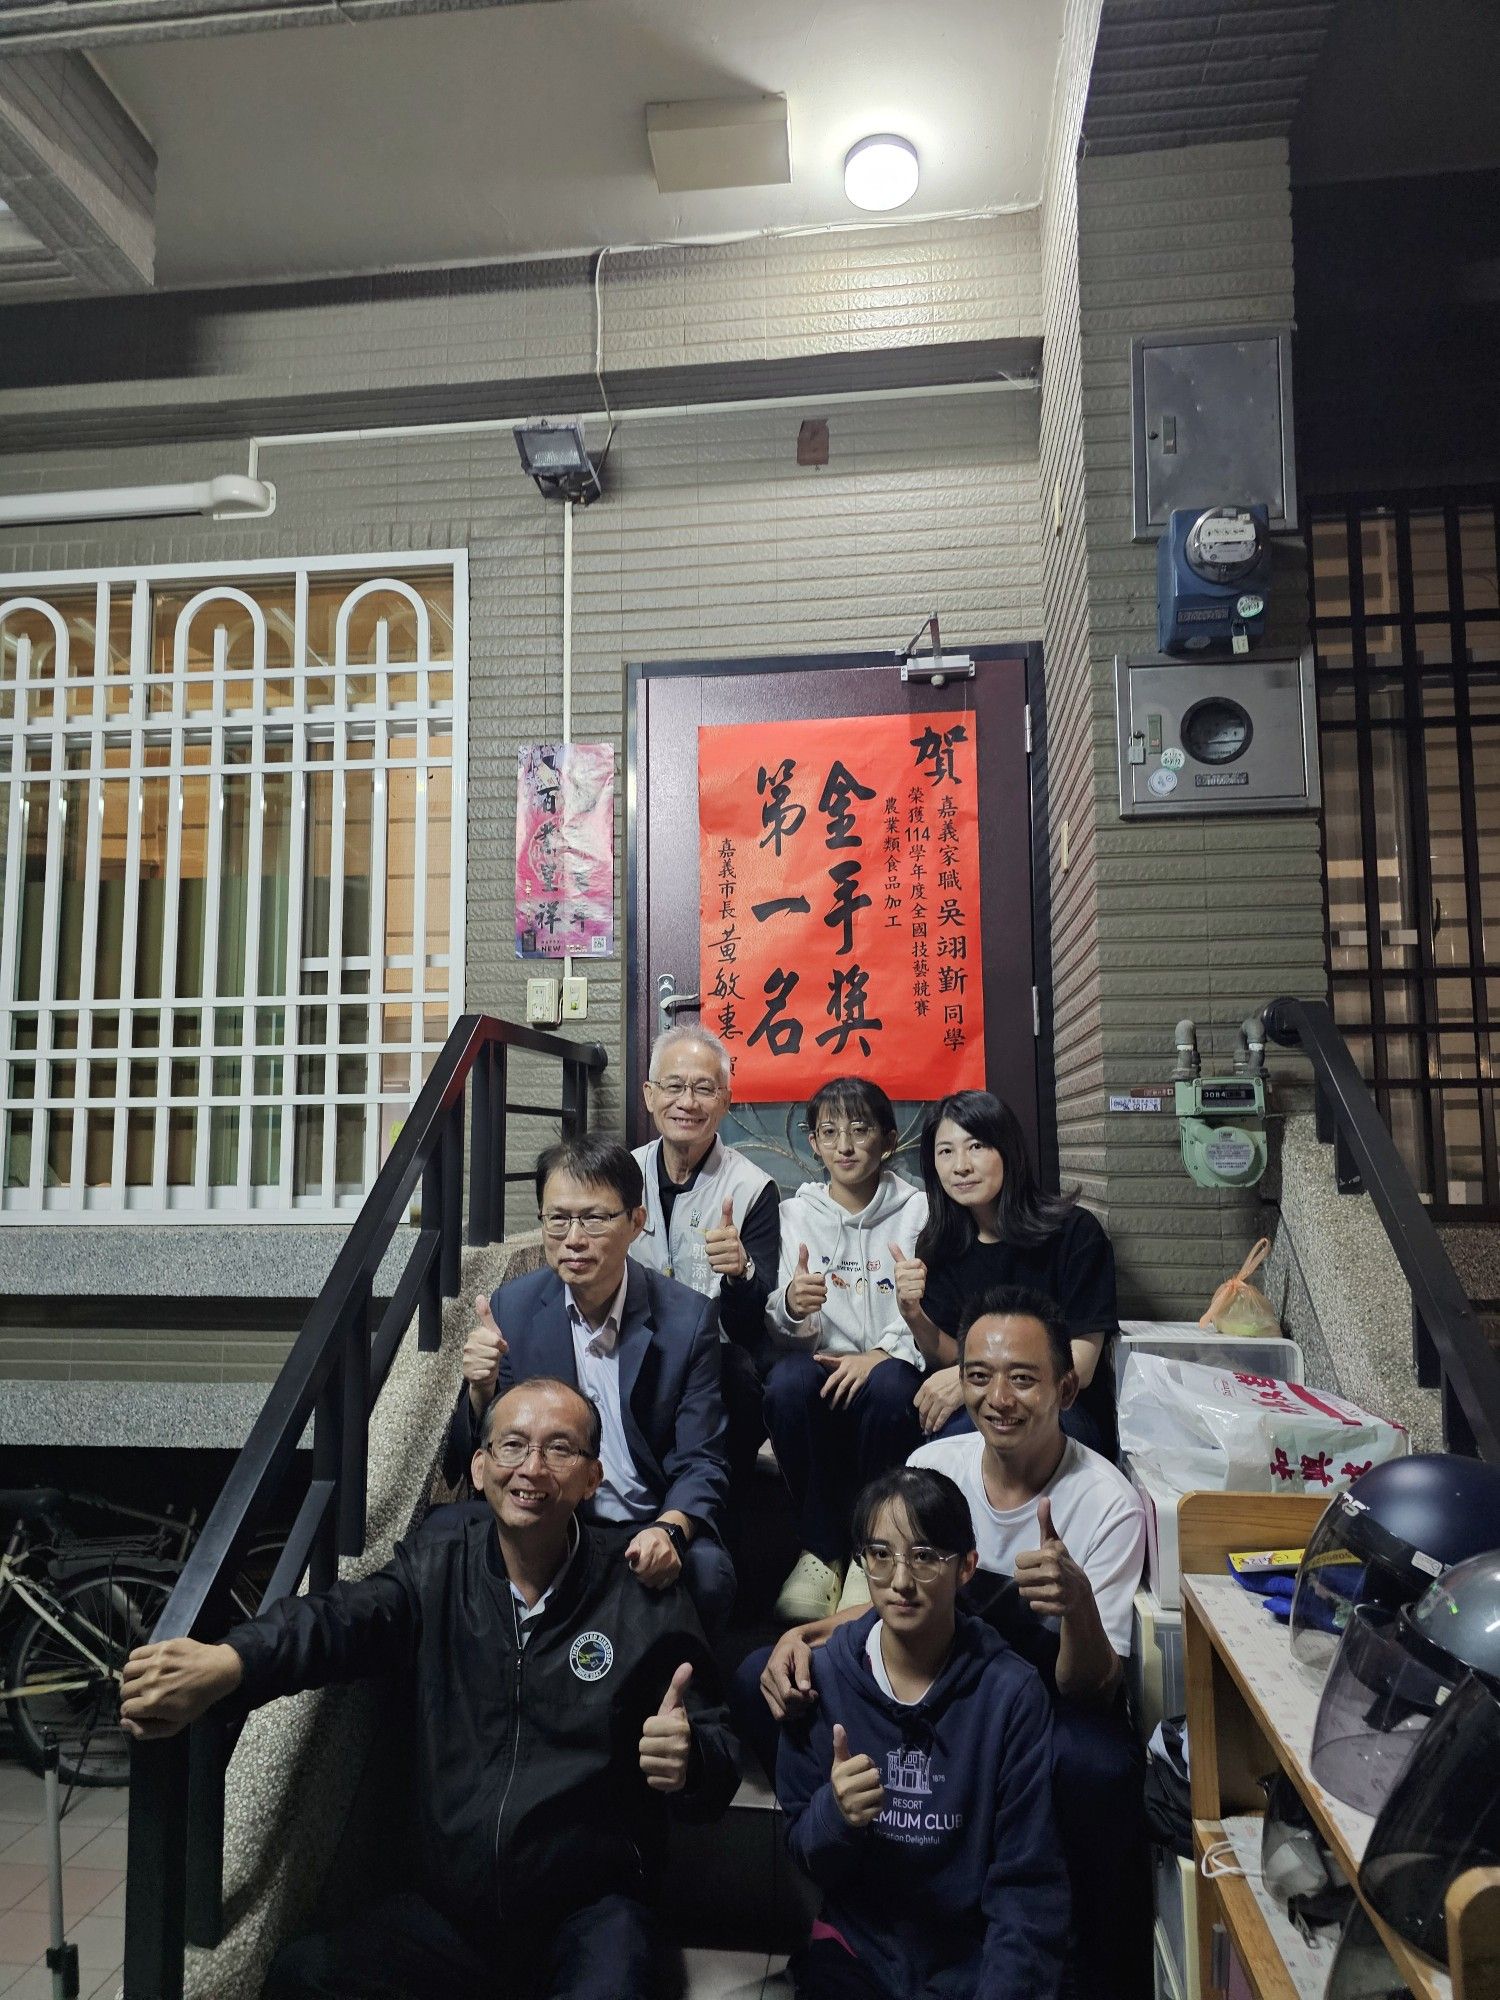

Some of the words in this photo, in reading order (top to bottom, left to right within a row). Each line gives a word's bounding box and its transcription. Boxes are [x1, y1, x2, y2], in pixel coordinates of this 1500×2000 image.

[909, 725, 969, 787] 賀
[883, 796, 902, 928] 農業類食品加工
[747, 758, 812, 1058] 第一名
[814, 759, 883, 1058] 金手獎
[904, 786, 931, 1017] 榮獲114學年度全國技藝競賽
[577, 1634, 597, 1646] UNITED
[598, 1635, 611, 1665] KINGDOM
[892, 1797, 923, 1810] RESORT
[924, 1813, 964, 1831] CLUB
[905, 1834, 941, 1847] Delightful
